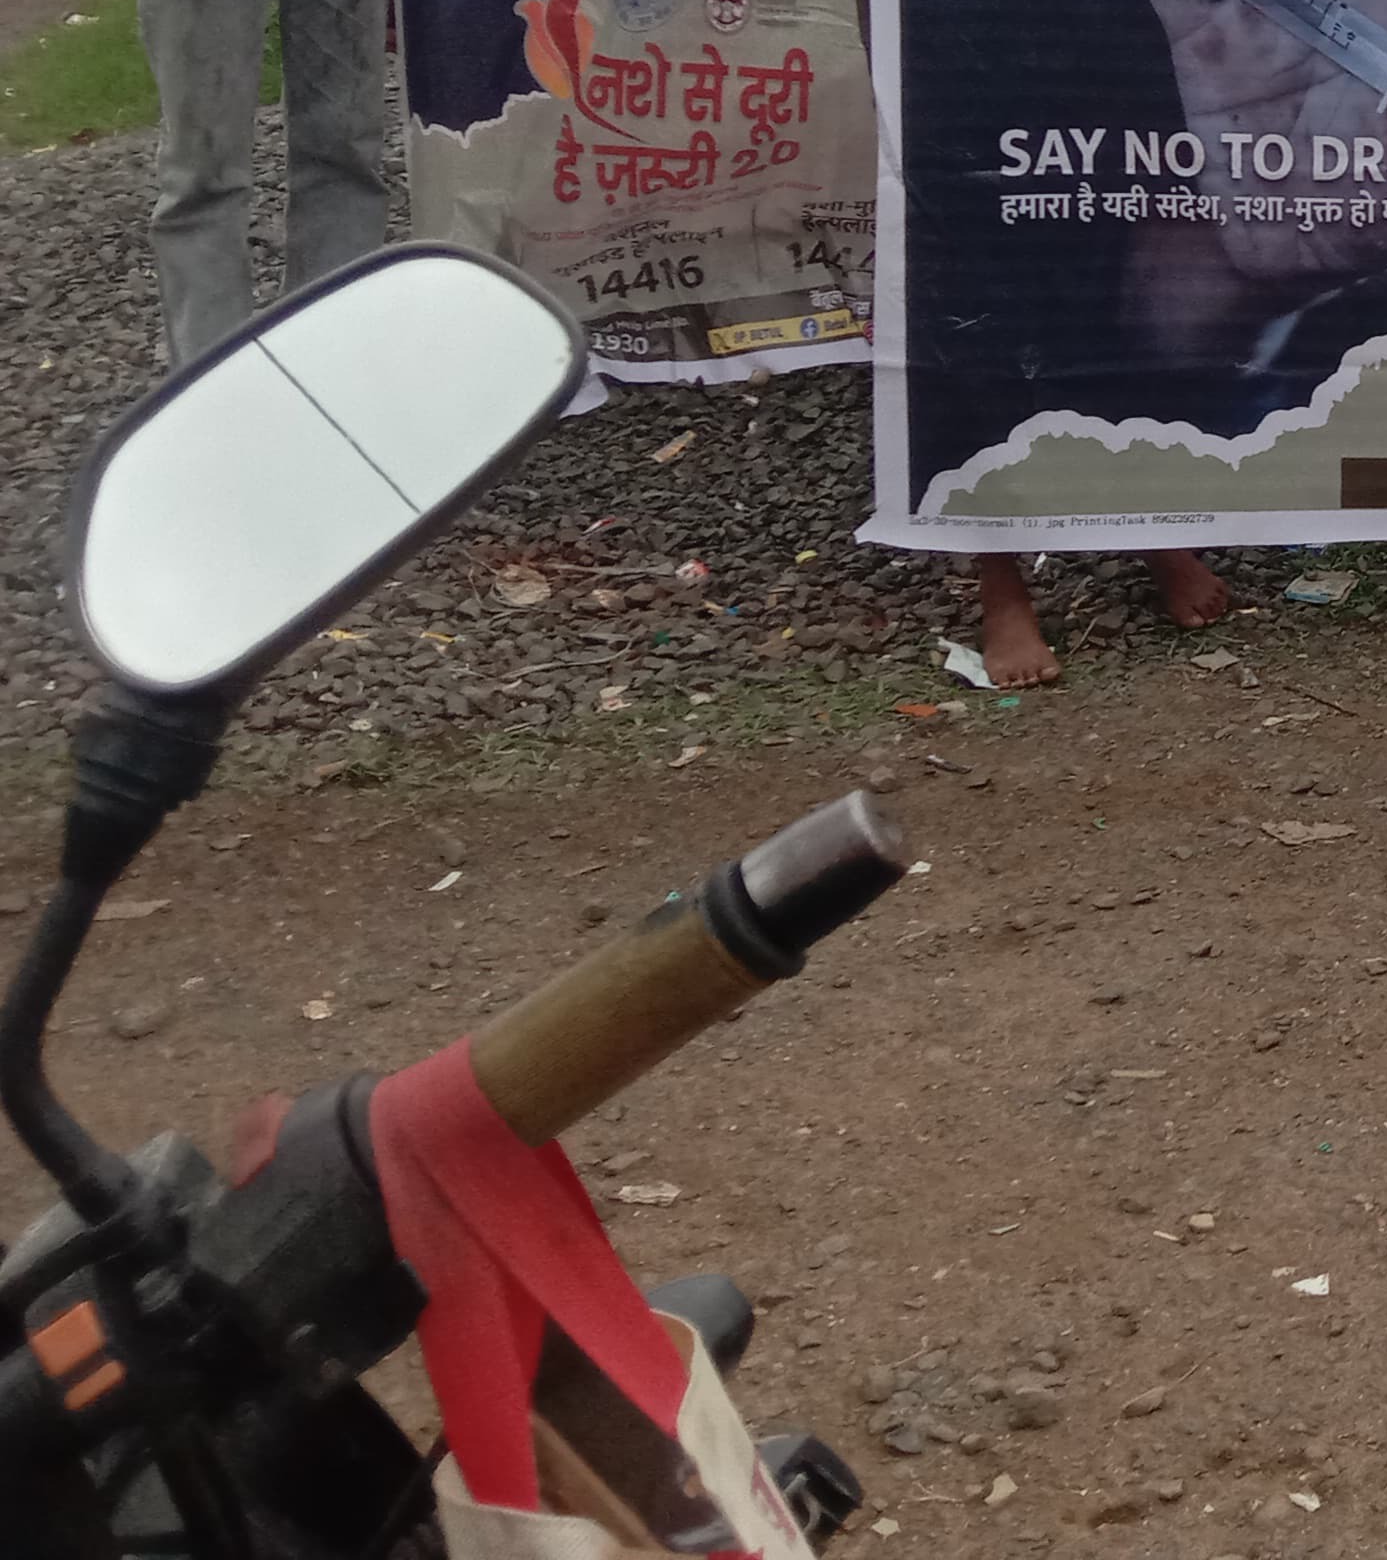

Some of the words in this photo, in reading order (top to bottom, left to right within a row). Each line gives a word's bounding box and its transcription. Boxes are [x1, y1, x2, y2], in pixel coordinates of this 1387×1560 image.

[587, 42, 672, 119] नशे
[681, 43, 729, 123] से
[737, 47, 814, 145] दूरी
[553, 113, 584, 204] है
[999, 128, 1107, 177] SAY
[1124, 129, 1205, 178] NO
[1220, 132, 1295, 181] TO
[1000, 193, 1072, 224] हमारा
[1076, 182, 1096, 222] है
[1102, 184, 1149, 222] यही
[1155, 185, 1228, 226] संदेश,
[1233, 195, 1345, 232] नशा-मुक्त
[1350, 190, 1377, 227] हो
[577, 255, 704, 304] 14416
[591, 332, 649, 355] 1930
